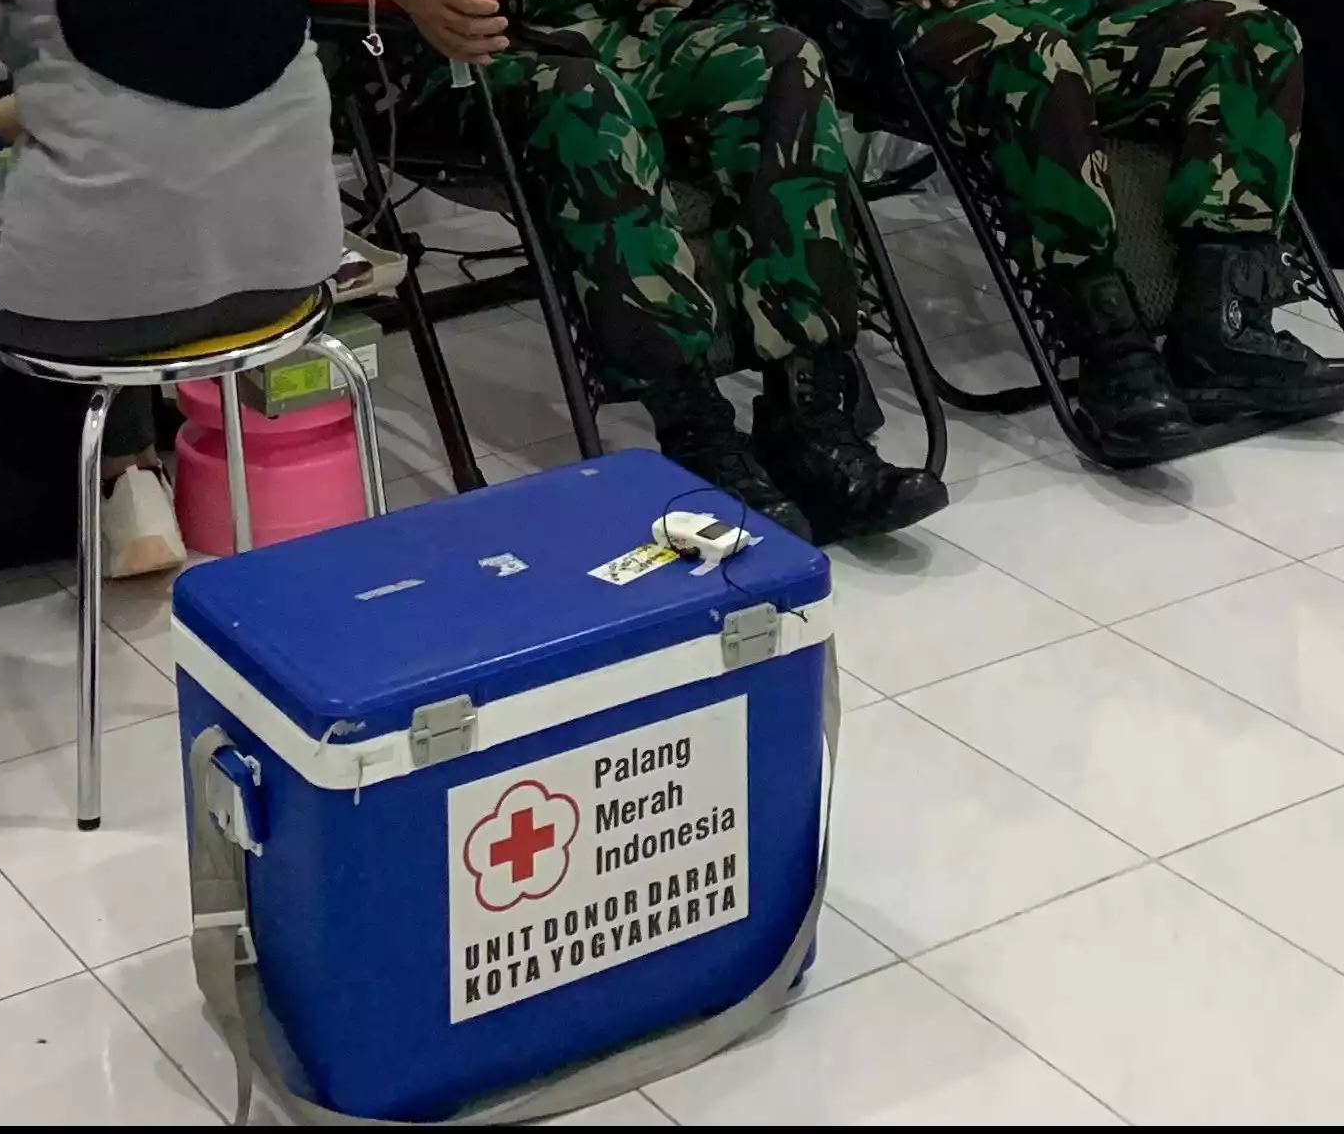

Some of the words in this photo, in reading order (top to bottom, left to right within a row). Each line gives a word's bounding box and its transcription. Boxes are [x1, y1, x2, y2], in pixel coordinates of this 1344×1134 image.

[594, 737, 691, 789] Palang
[595, 780, 683, 834] Merah
[596, 806, 736, 876] Indonesia
[465, 925, 534, 970] UNIT
[544, 888, 639, 944] DONOR
[648, 853, 737, 906] DARAH
[465, 954, 542, 1003] KOTA
[550, 884, 737, 973] YOGYAKARTA
